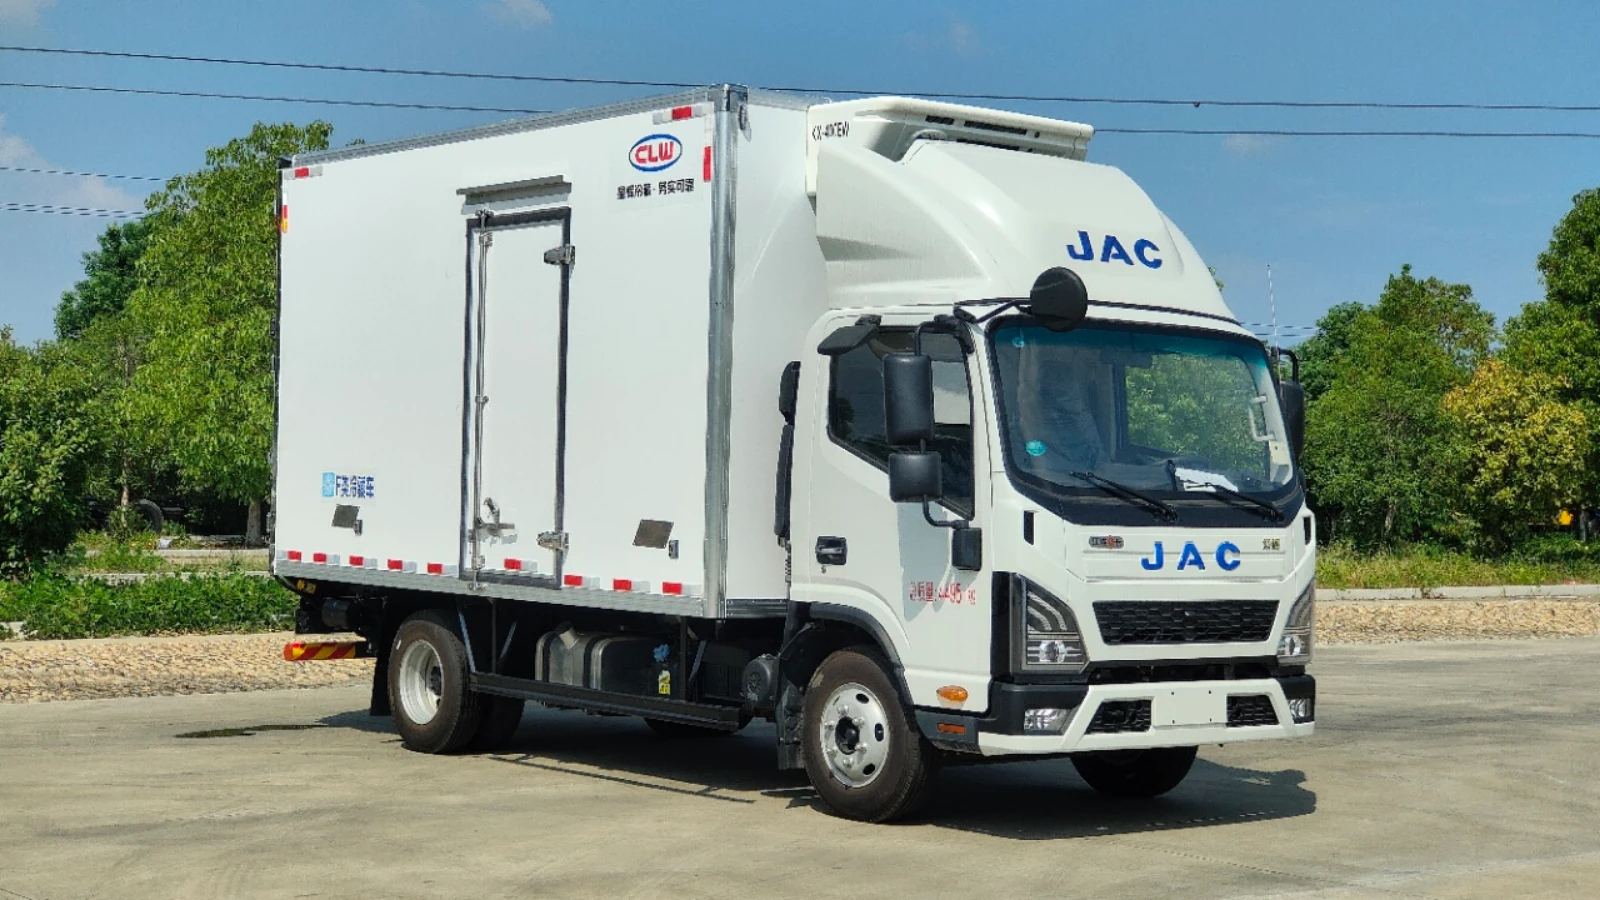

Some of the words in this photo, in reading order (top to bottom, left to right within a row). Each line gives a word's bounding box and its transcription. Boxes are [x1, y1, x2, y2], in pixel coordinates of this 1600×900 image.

[634, 141, 674, 164] CLW
[1066, 230, 1163, 269] JAC
[336, 475, 374, 498] F类冷藏车
[1141, 541, 1241, 571] JAC
